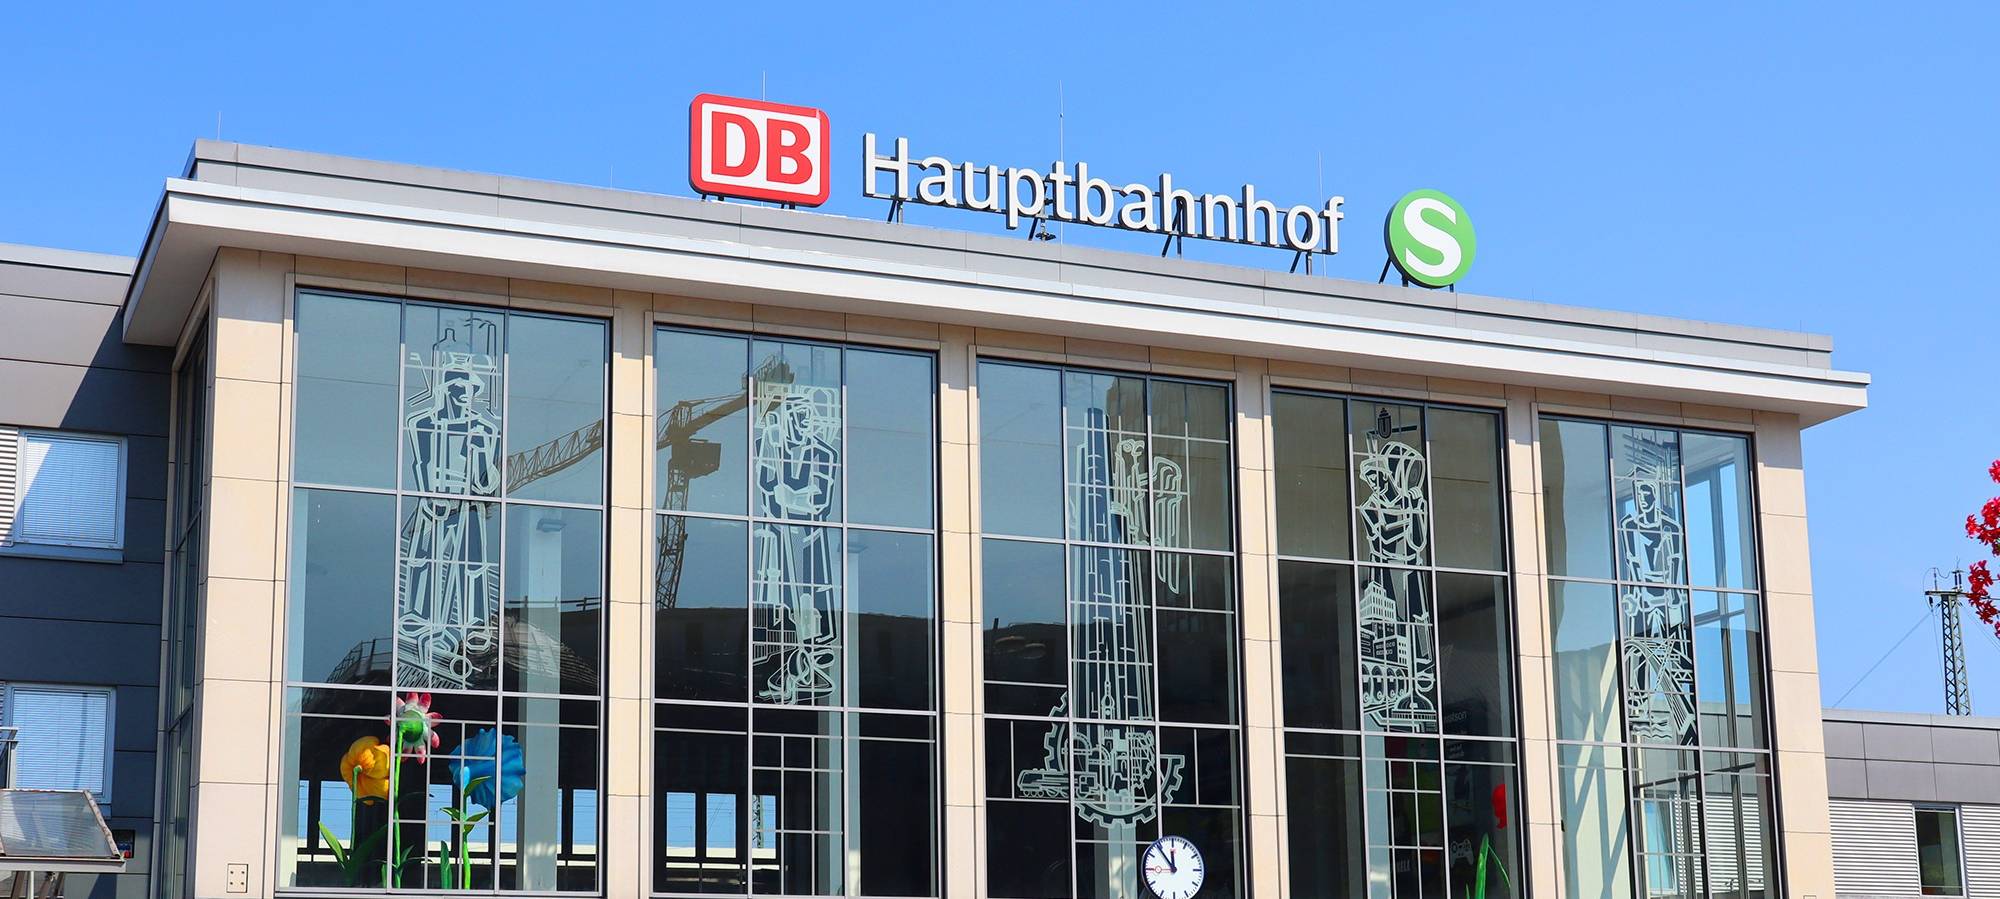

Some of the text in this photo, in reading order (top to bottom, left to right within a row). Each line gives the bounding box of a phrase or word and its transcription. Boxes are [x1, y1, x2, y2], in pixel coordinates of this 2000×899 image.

[711, 110, 813, 185] DB
[863, 132, 1345, 255] Hauptbahnhof
[1403, 197, 1462, 278] S
